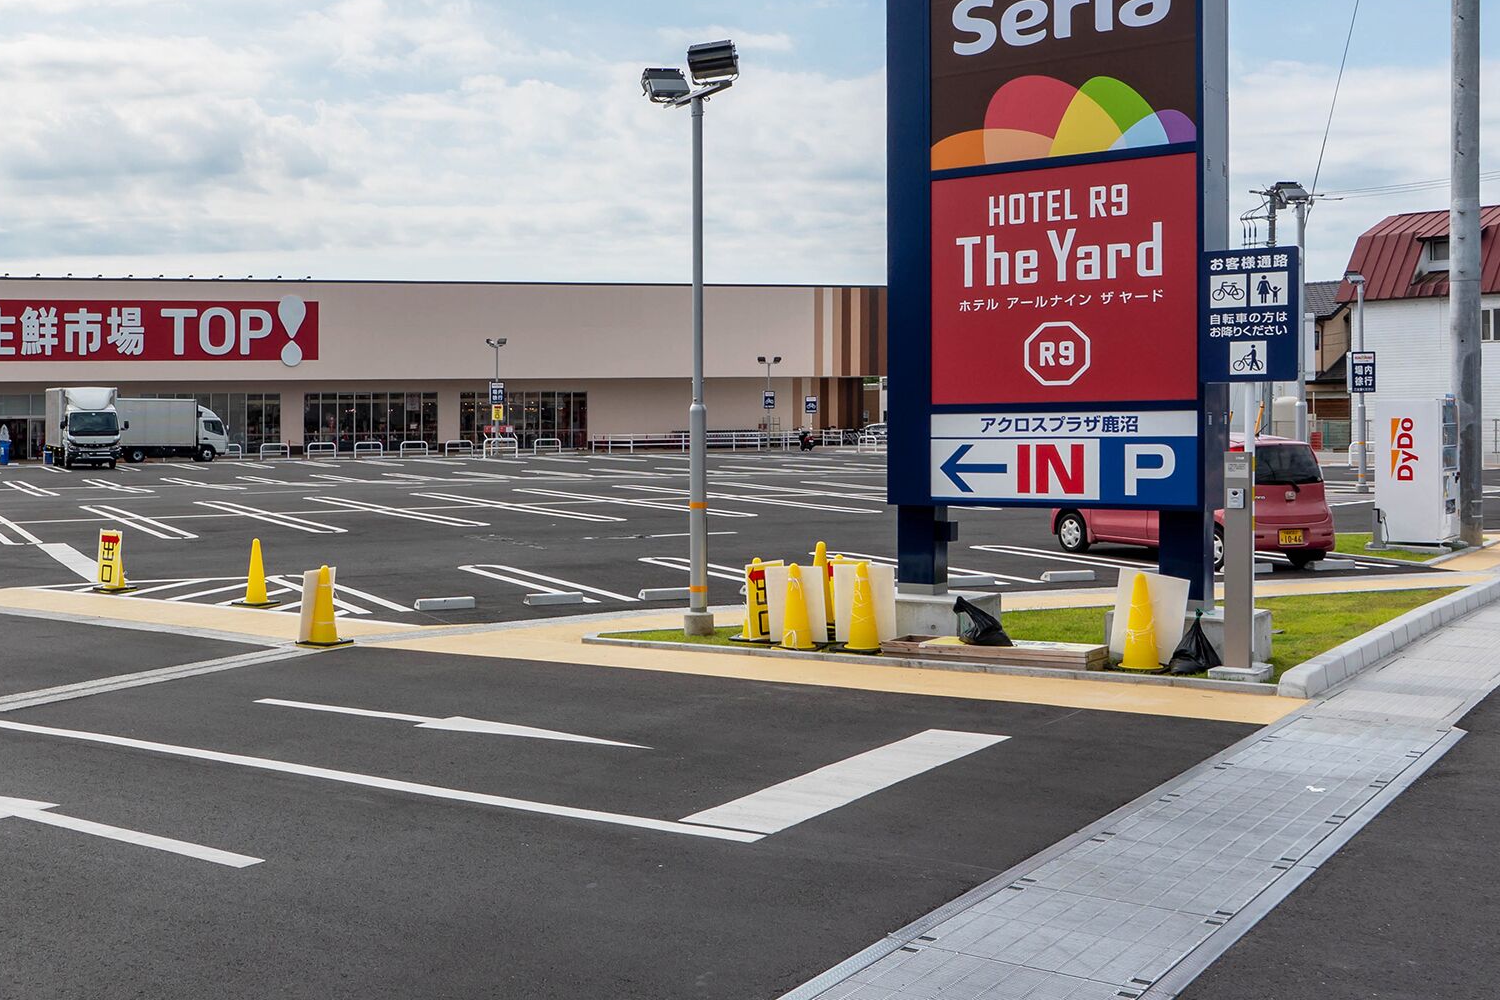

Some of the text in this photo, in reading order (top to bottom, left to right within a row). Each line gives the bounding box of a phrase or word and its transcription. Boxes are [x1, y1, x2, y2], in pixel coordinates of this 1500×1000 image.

[988, 183, 1128, 227] HOTEL R9
[956, 221, 1163, 288] The Yard
[1209, 254, 1288, 271] お客様通路
[958, 289, 1164, 312] ホテル アールナイン ザ ヤード
[1209, 311, 1288, 325] 自転車の方は
[1209, 325, 1288, 338] お降りください
[1039, 341, 1075, 366] R9
[980, 415, 1139, 433] アクロスプラザ鹿沼
[1397, 417, 1419, 481] DyDo
[1016, 443, 1085, 494] IN
[1124, 443, 1176, 496] P
